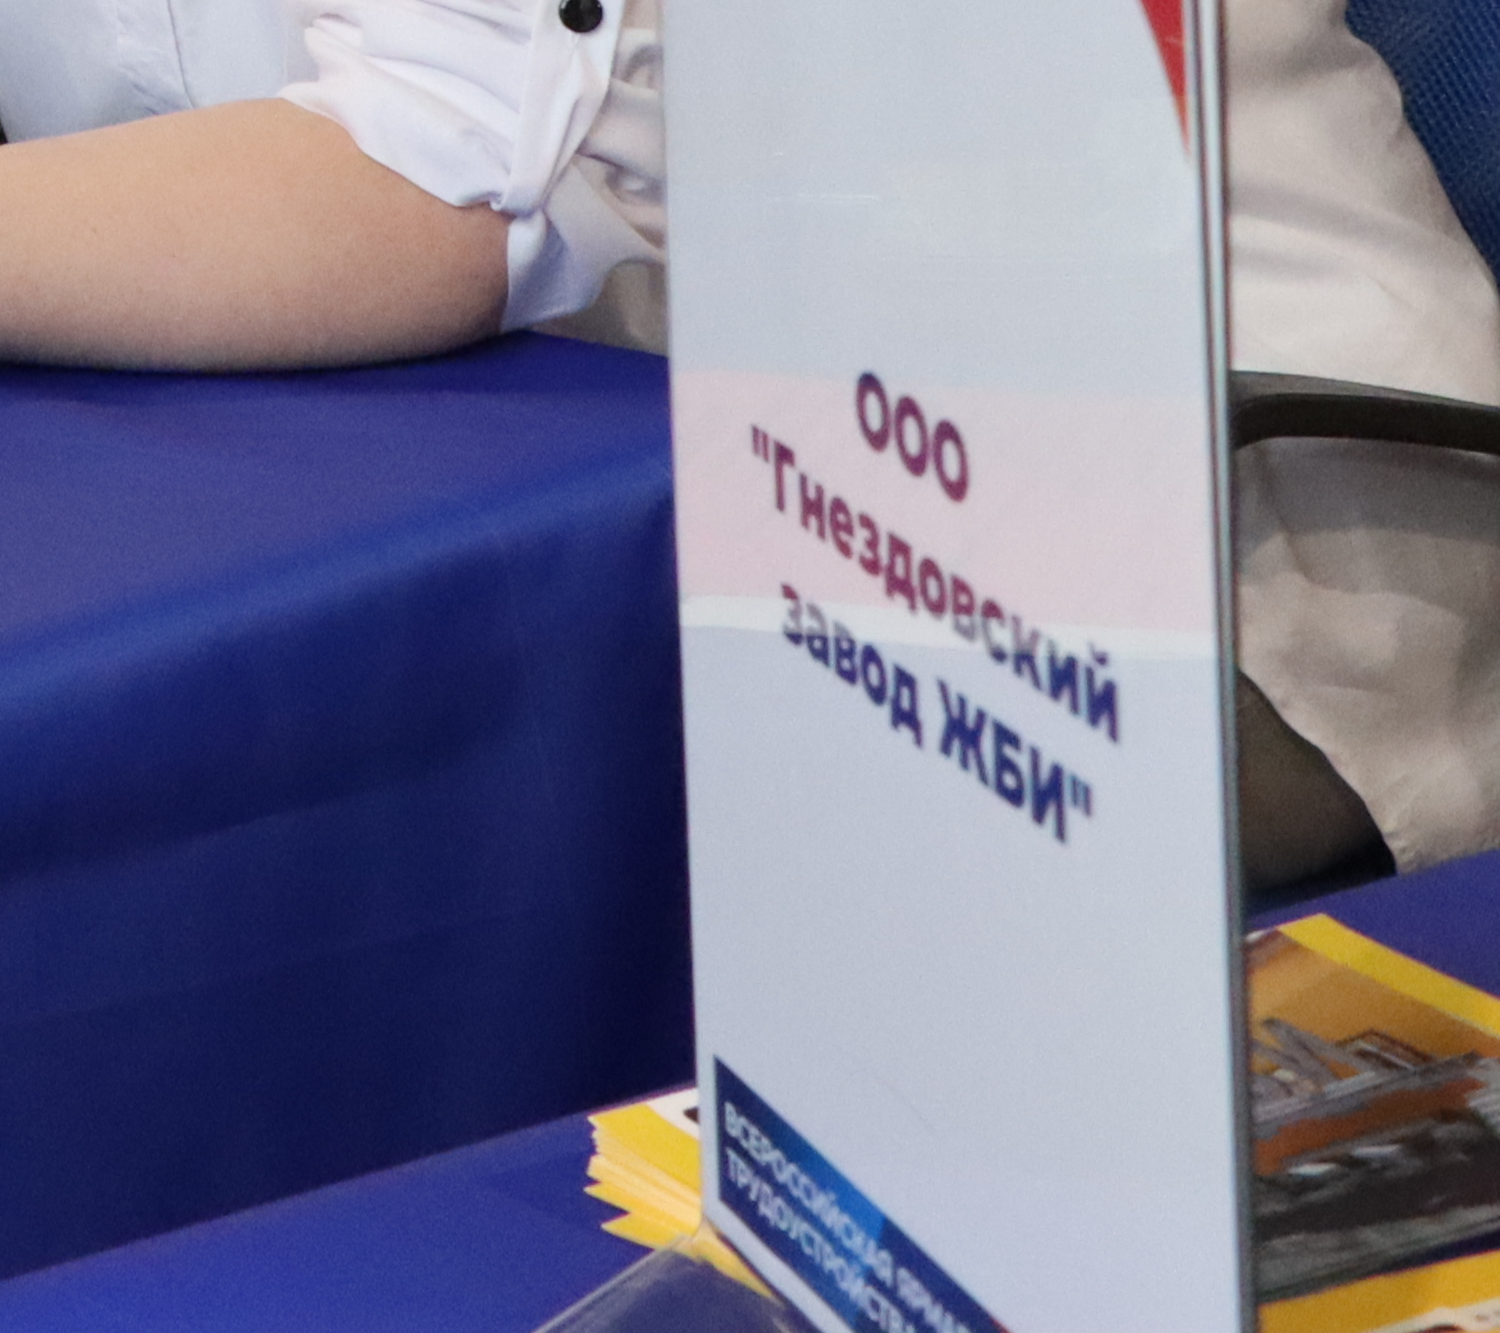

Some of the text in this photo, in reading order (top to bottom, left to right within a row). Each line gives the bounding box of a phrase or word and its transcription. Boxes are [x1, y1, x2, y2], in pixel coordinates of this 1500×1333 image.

[856, 371, 970, 503] ООО
[750, 423, 1120, 744] "Гнездовский
[780, 582, 1093, 844] завод ЖБИ"
